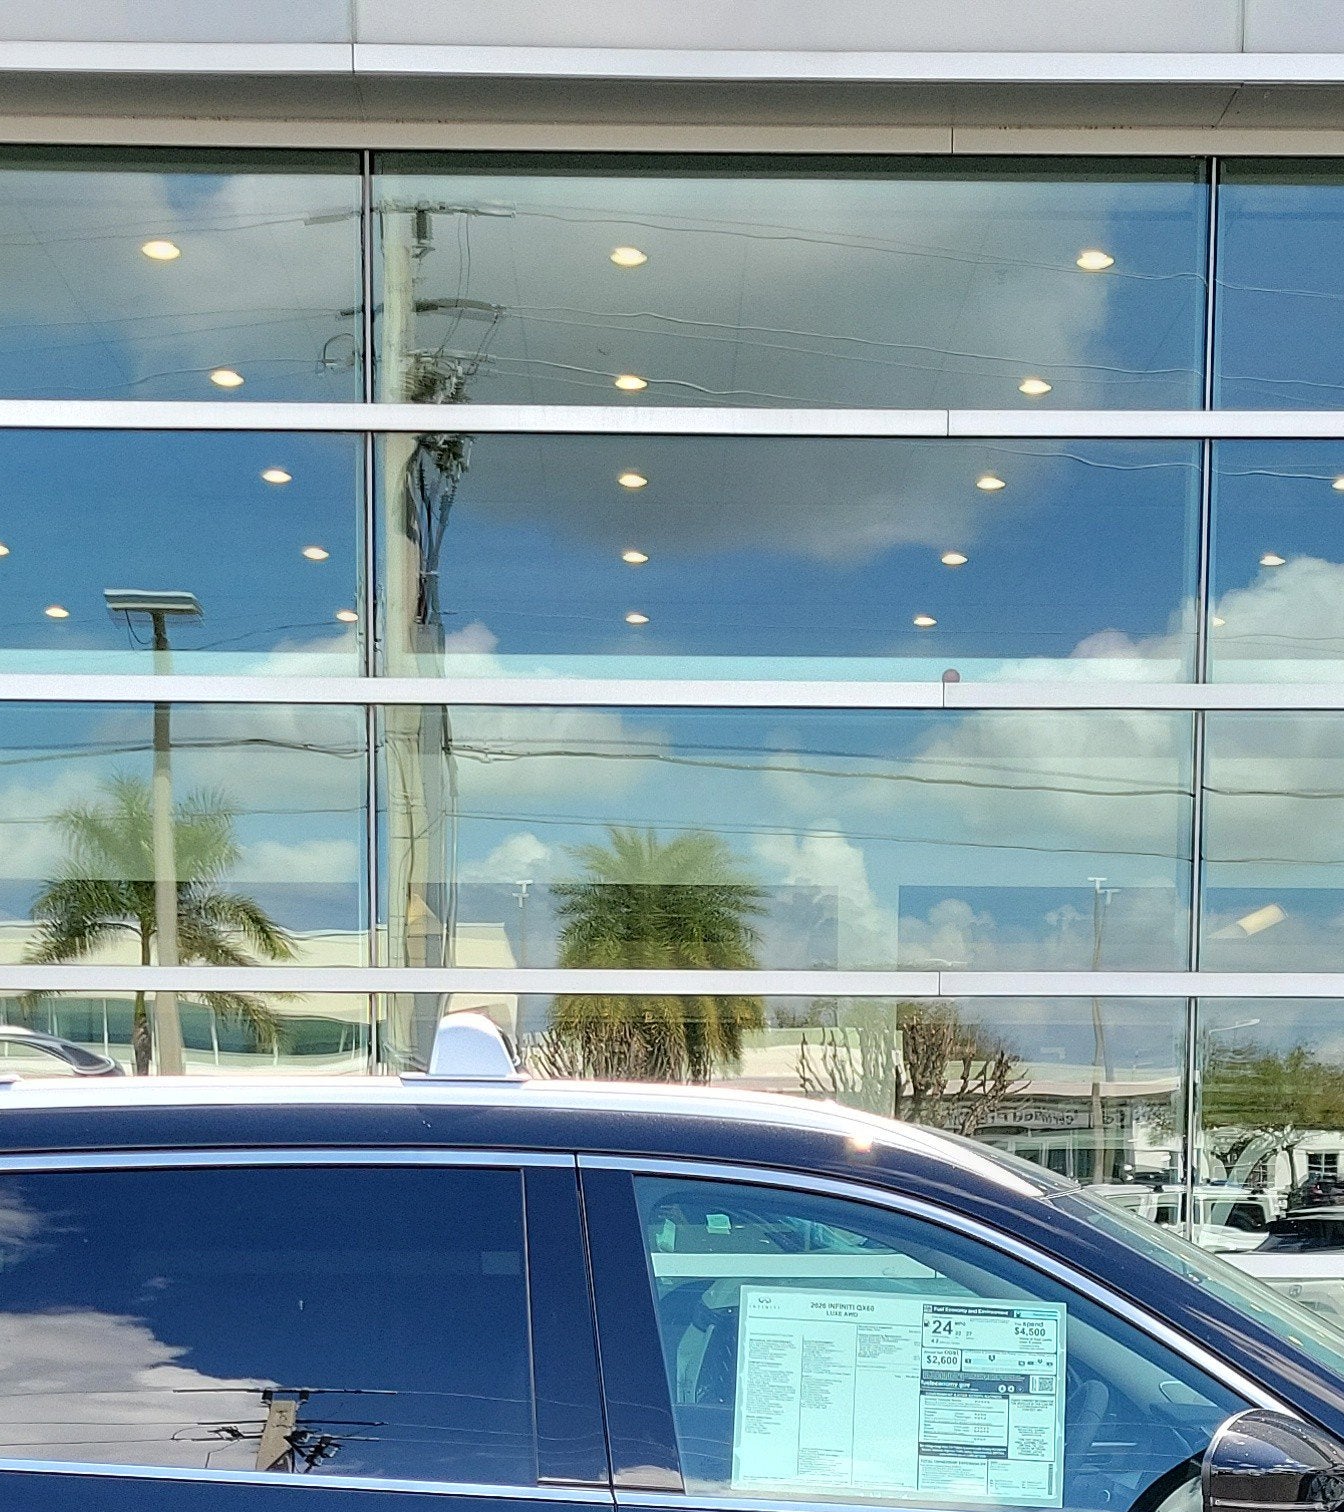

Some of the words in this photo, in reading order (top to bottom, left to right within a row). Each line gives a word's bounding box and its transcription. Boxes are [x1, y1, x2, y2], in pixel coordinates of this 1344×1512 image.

[828, 1302, 855, 1311] INFINITI
[856, 1304, 875, 1312] QX60
[945, 1307, 968, 1315] Economy
[932, 1320, 953, 1335] 24
[1014, 1327, 1046, 1337] $4,500
[926, 1355, 958, 1366] $2,600
